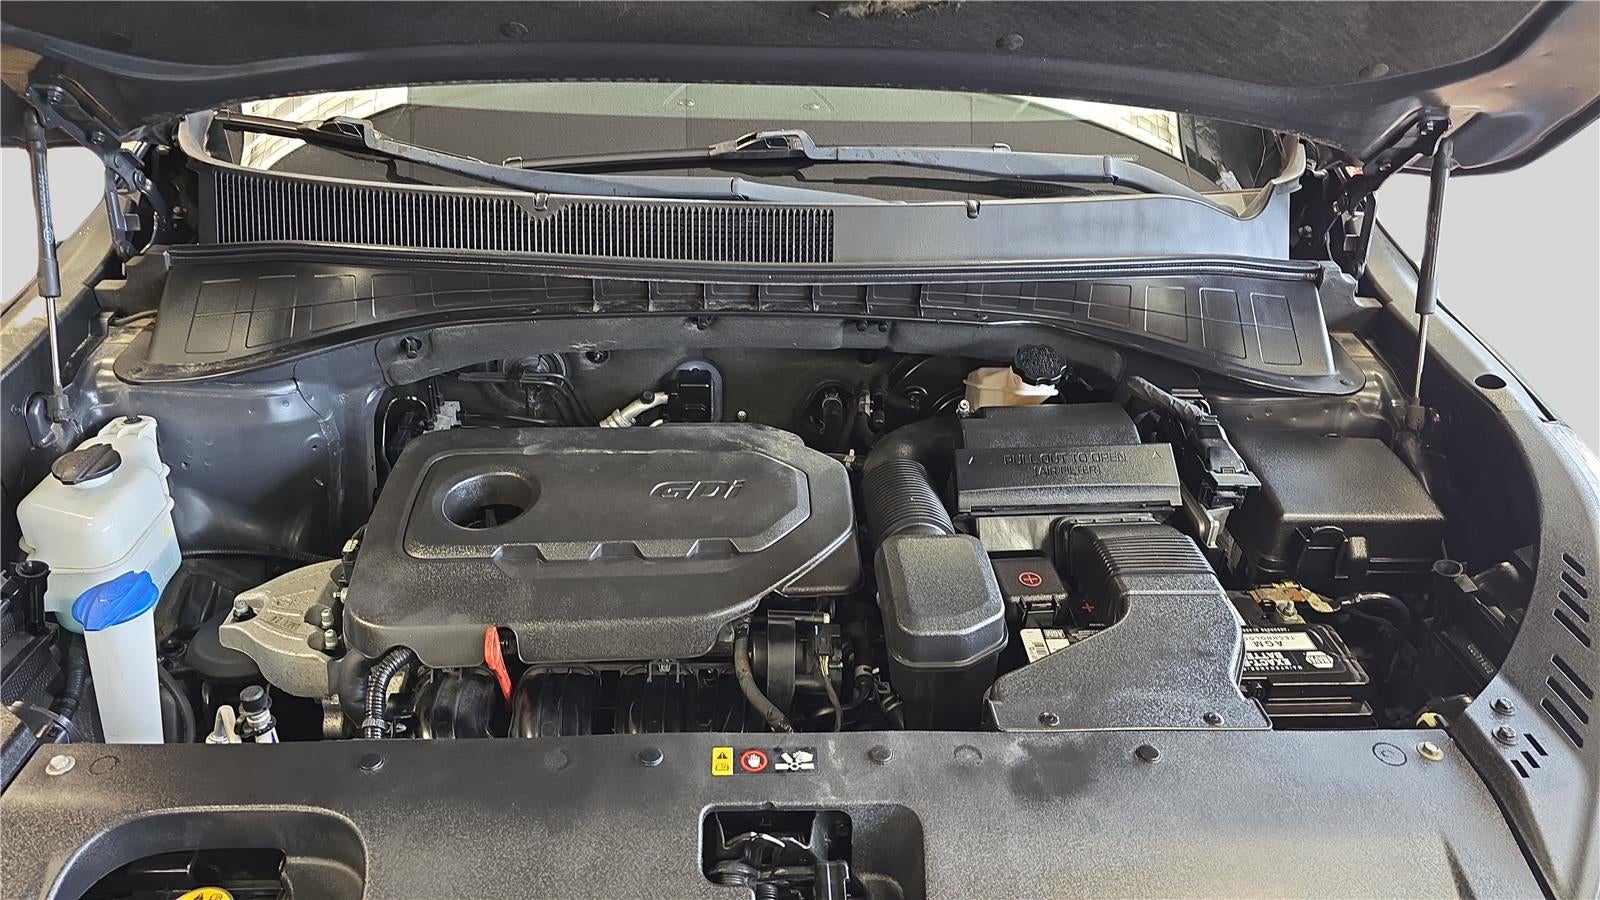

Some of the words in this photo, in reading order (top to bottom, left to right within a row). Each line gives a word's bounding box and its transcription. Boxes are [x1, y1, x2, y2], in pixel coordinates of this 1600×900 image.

[1003, 454, 1038, 465] PULL
[1040, 452, 1067, 464] OUT
[1070, 452, 1088, 463] TO
[1090, 451, 1127, 462] OPEN
